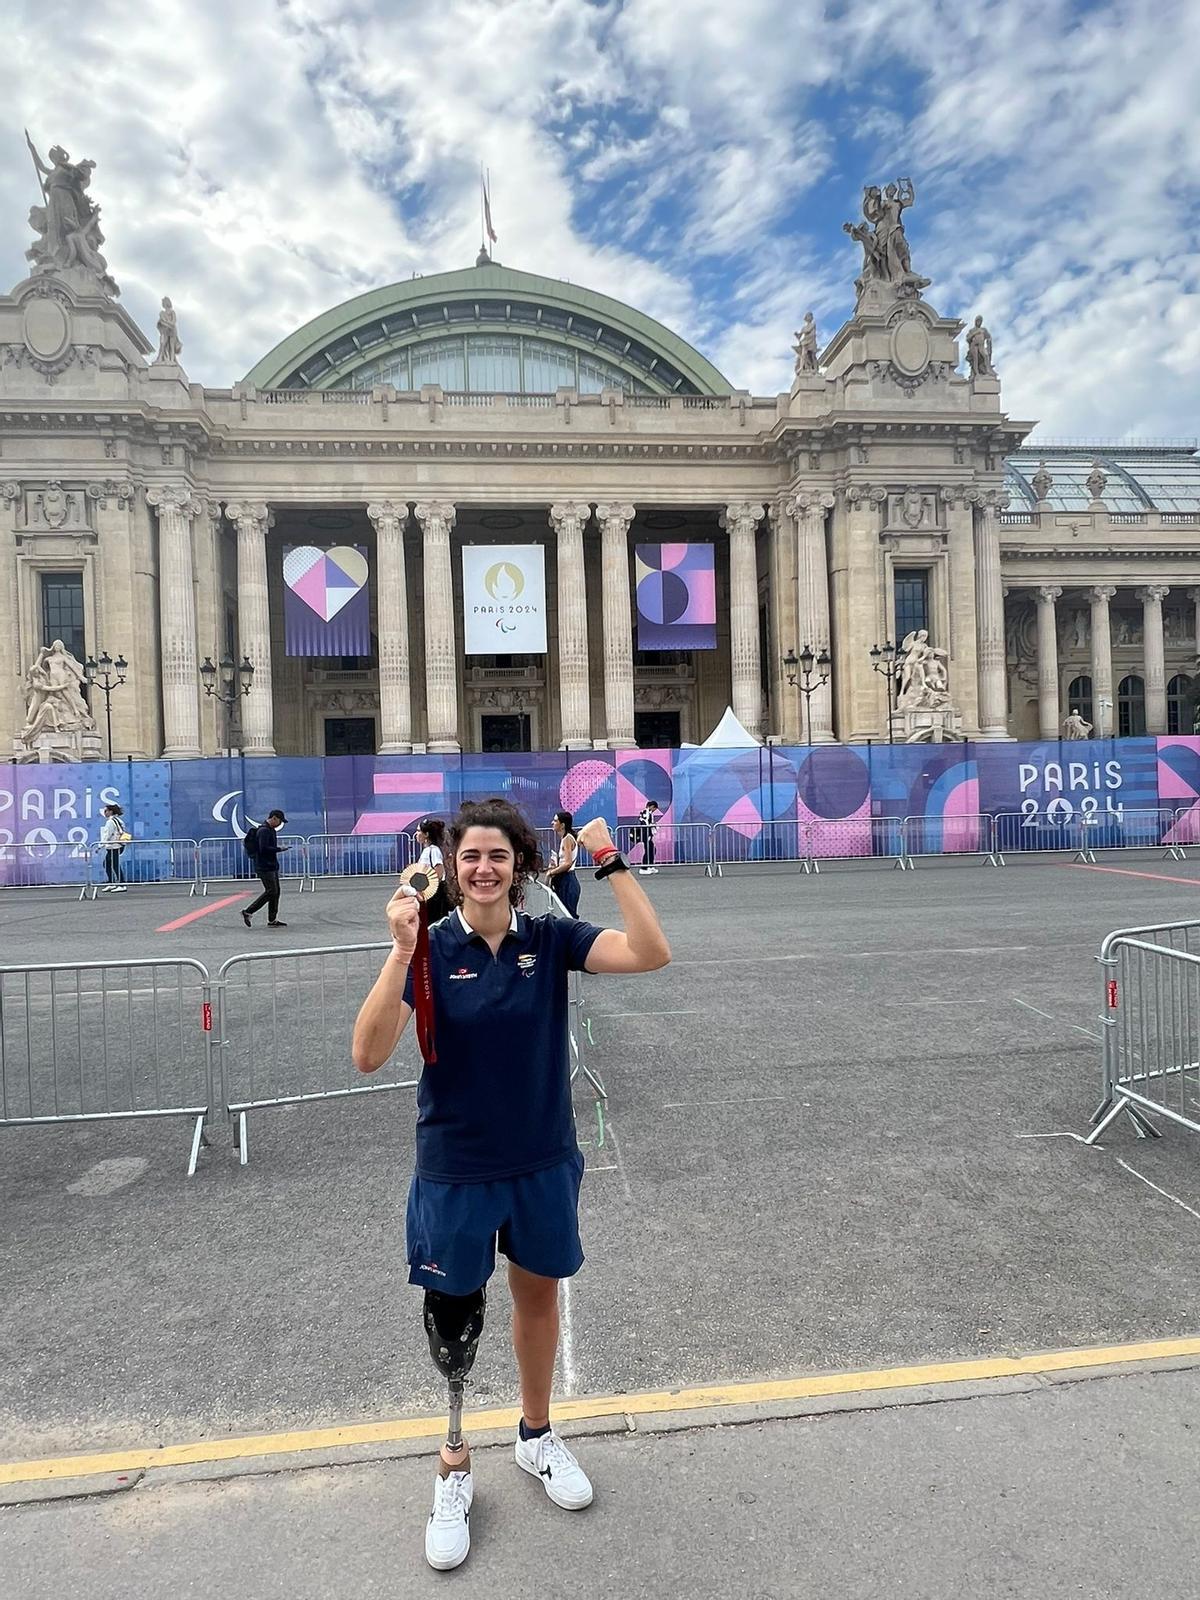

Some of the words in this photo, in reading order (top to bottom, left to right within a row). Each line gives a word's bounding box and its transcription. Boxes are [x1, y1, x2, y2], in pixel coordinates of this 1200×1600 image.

[509, 605, 537, 613] 2024
[1020, 796, 1124, 827] 2024
[0, 826, 105, 860] 202
